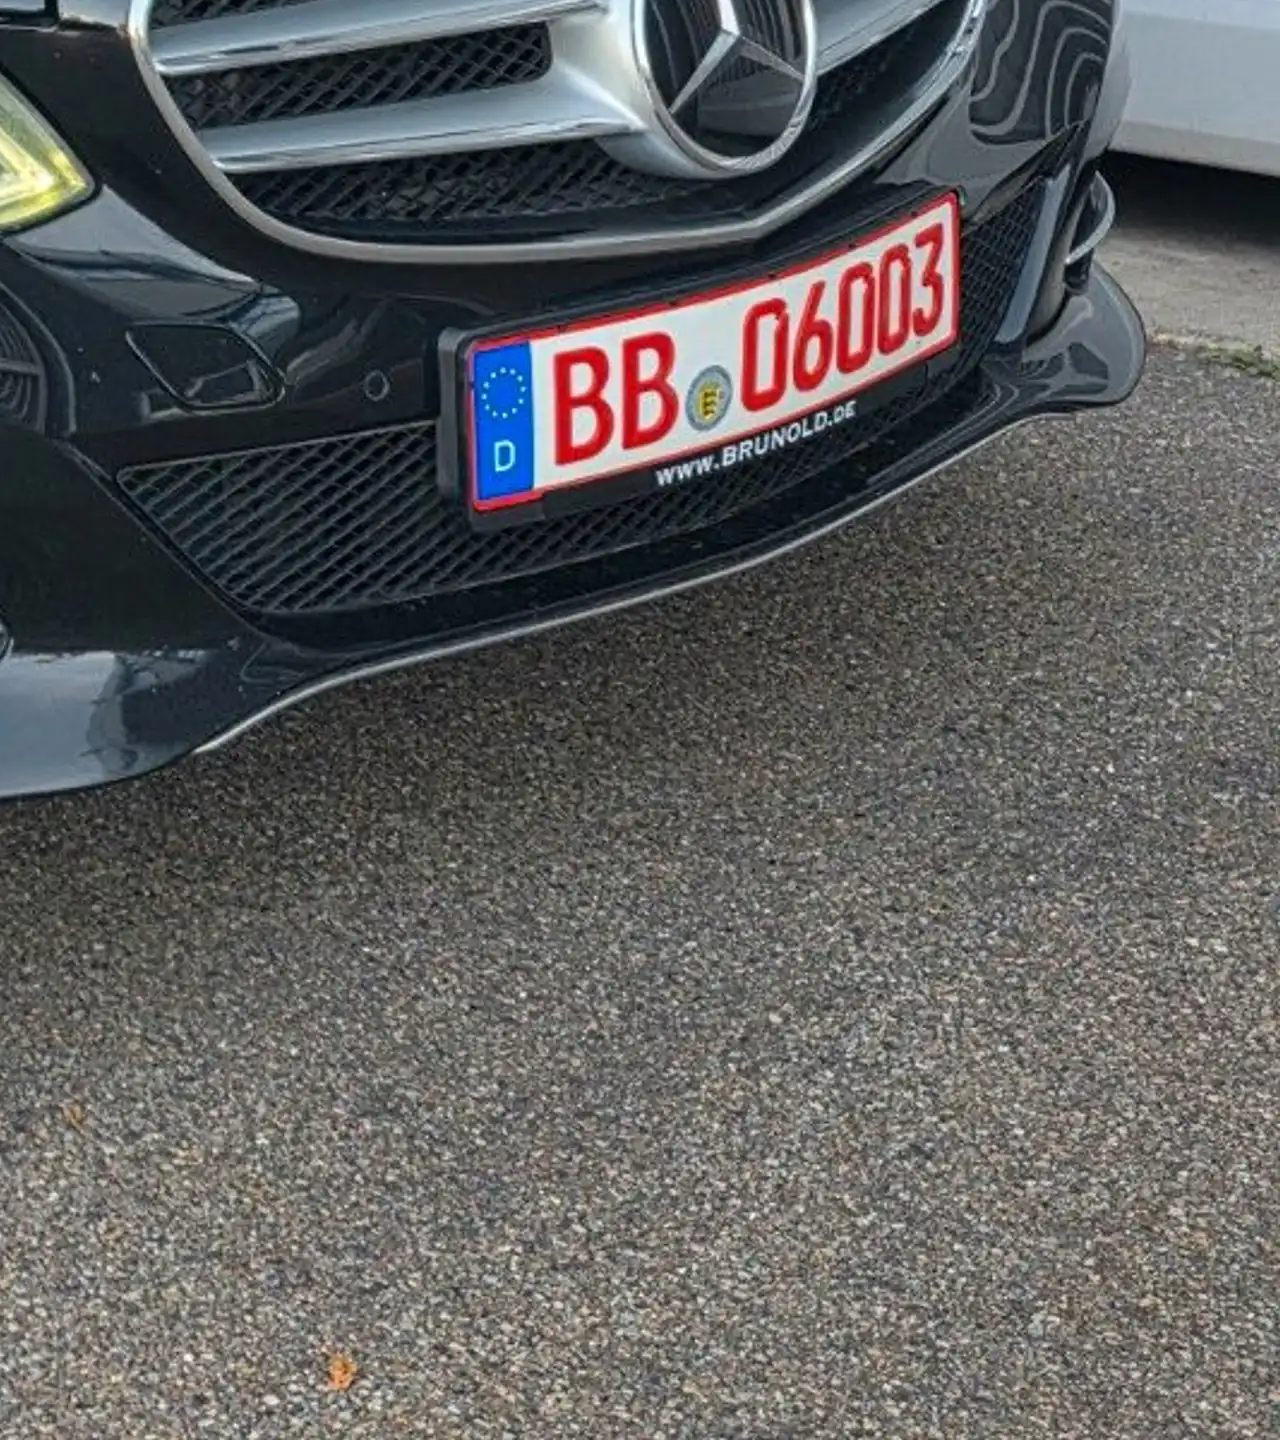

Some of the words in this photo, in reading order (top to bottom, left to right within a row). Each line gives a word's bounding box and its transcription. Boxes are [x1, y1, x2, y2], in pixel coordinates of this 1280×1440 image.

[493, 439, 517, 472] D
[554, 331, 680, 466] BB
[742, 222, 944, 412] 06003
